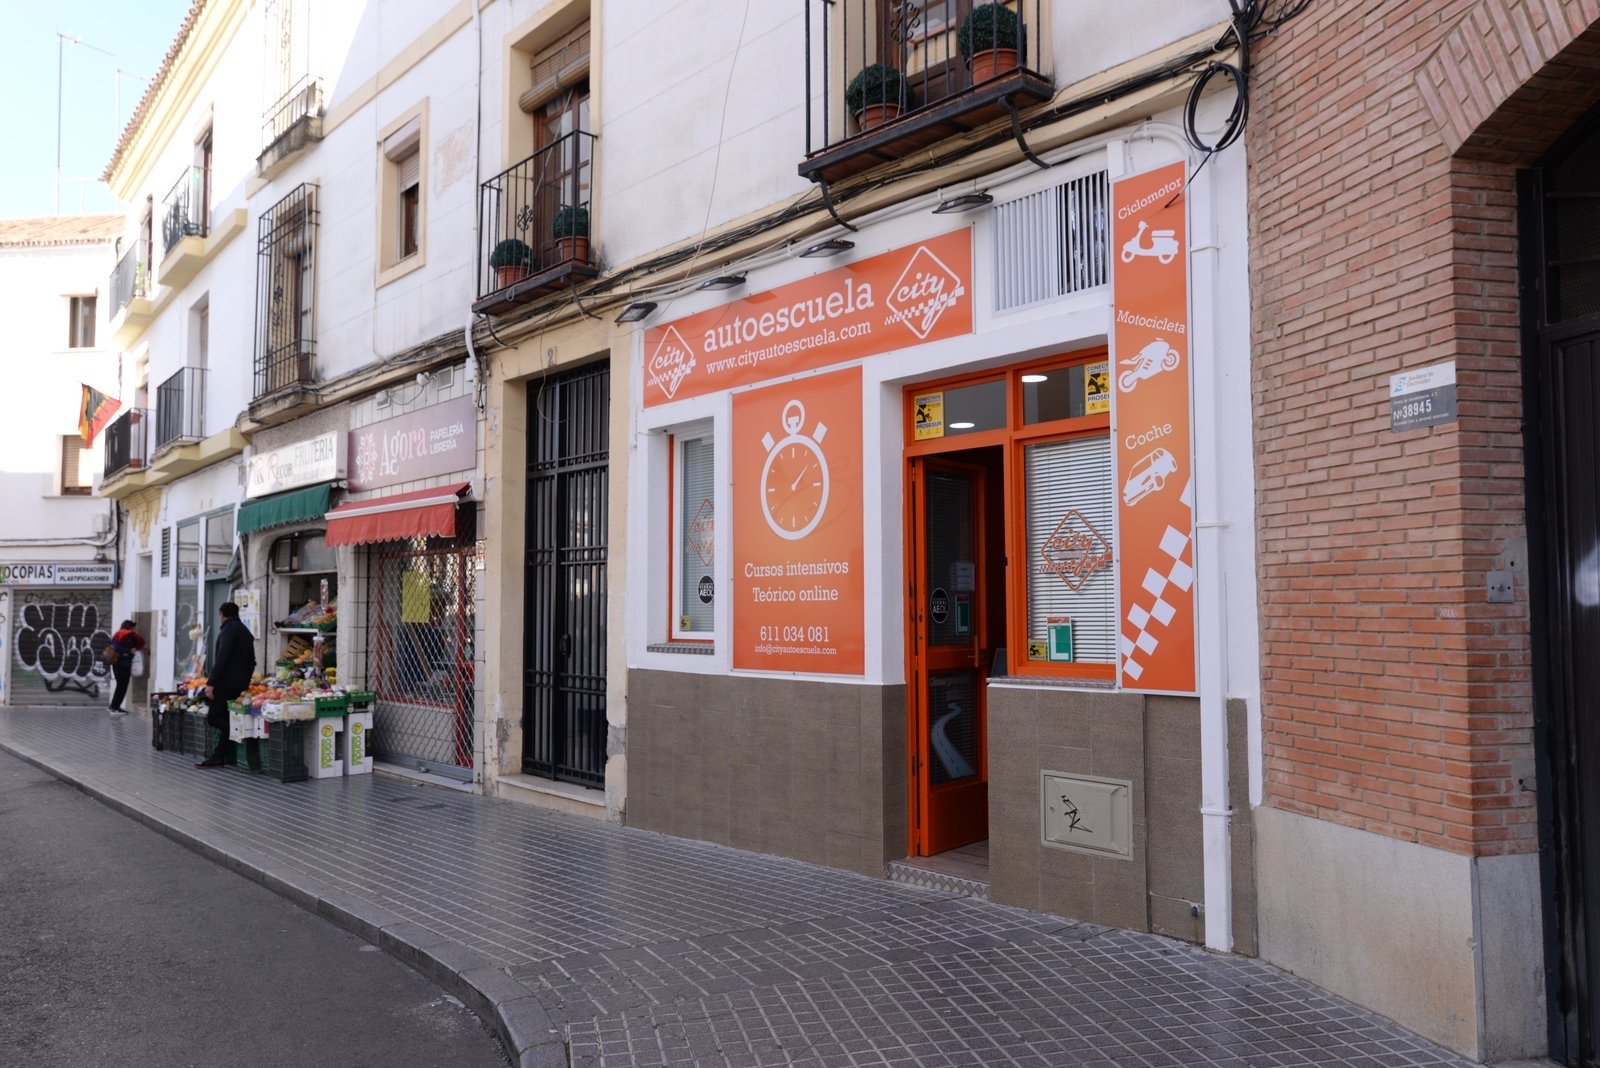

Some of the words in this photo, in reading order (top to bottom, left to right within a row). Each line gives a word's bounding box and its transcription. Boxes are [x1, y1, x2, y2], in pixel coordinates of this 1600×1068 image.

[1118, 178, 1182, 220] Ciclomotor
[704, 278, 875, 352] autoescuela
[897, 272, 944, 330] city
[1117, 310, 1186, 334] Motocicleta
[706, 321, 872, 374] www.cityautoescuela.com
[655, 346, 685, 392] city
[1125, 422, 1173, 450] Coche
[744, 563, 784, 578] Cursos
[786, 559, 849, 576] intensivos
[752, 586, 796, 602] Teórico
[799, 585, 839, 601] online
[760, 626, 780, 641] 611
[783, 626, 804, 642] 034
[807, 626, 829, 642] 081
[1050, 629, 1069, 660] L
[755, 643, 837, 655] info@cityautoescuela.com
